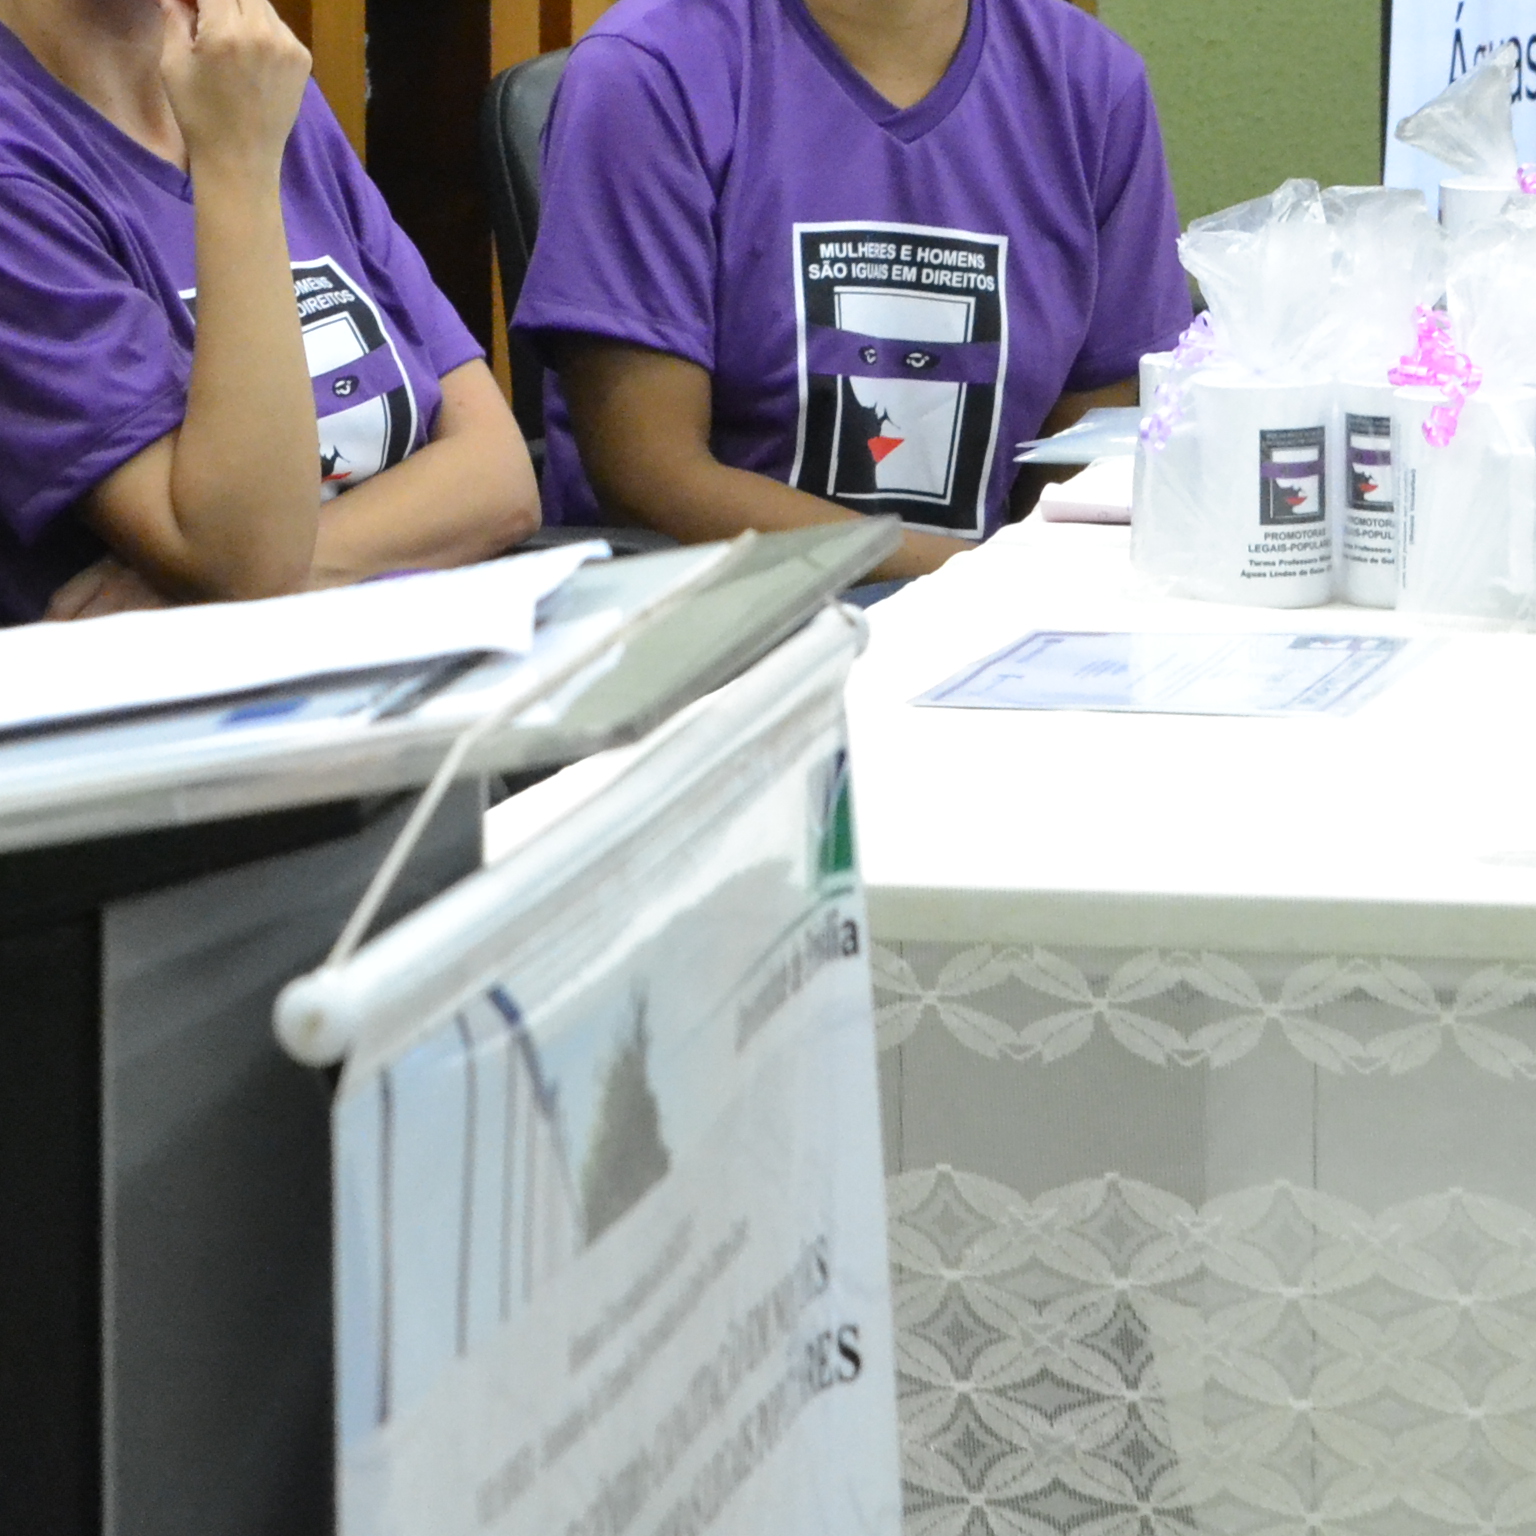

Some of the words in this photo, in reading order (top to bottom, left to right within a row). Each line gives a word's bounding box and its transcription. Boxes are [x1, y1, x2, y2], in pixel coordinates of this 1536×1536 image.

[818, 242, 896, 260] MULHERES
[900, 245, 913, 261] E
[917, 247, 985, 270] HOMENS
[808, 260, 847, 280] SÃO
[852, 263, 889, 280] IGUAIS
[891, 265, 917, 282] EM
[921, 268, 996, 292] DIREITOS
